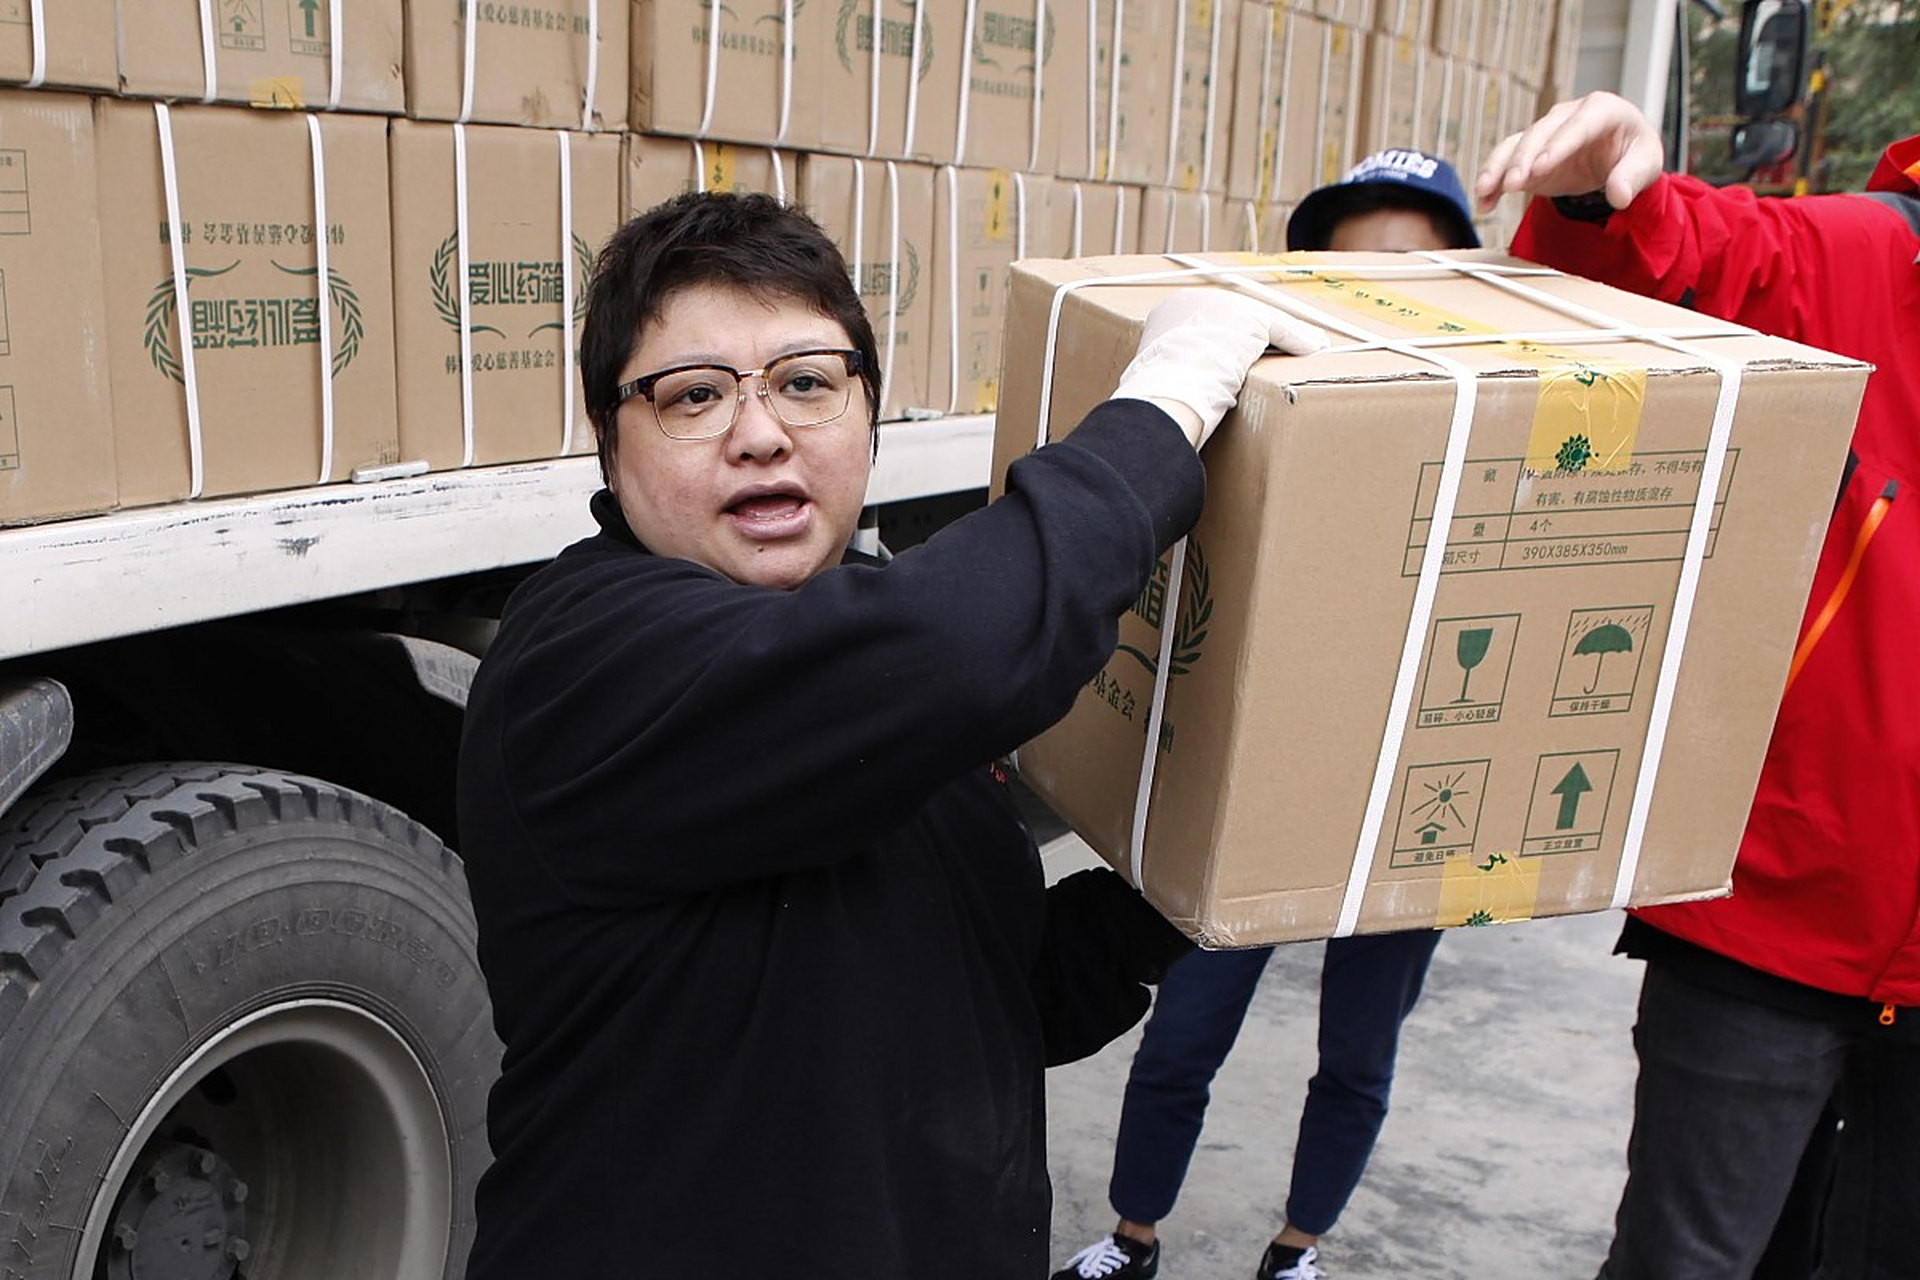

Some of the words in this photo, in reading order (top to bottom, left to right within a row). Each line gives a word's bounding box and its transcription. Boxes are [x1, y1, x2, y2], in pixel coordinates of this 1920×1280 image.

[445, 349, 554, 374] 韩爱心慈善基金会
[1530, 518, 1552, 533] 4个
[1522, 542, 1629, 561] 390X385X350mm
